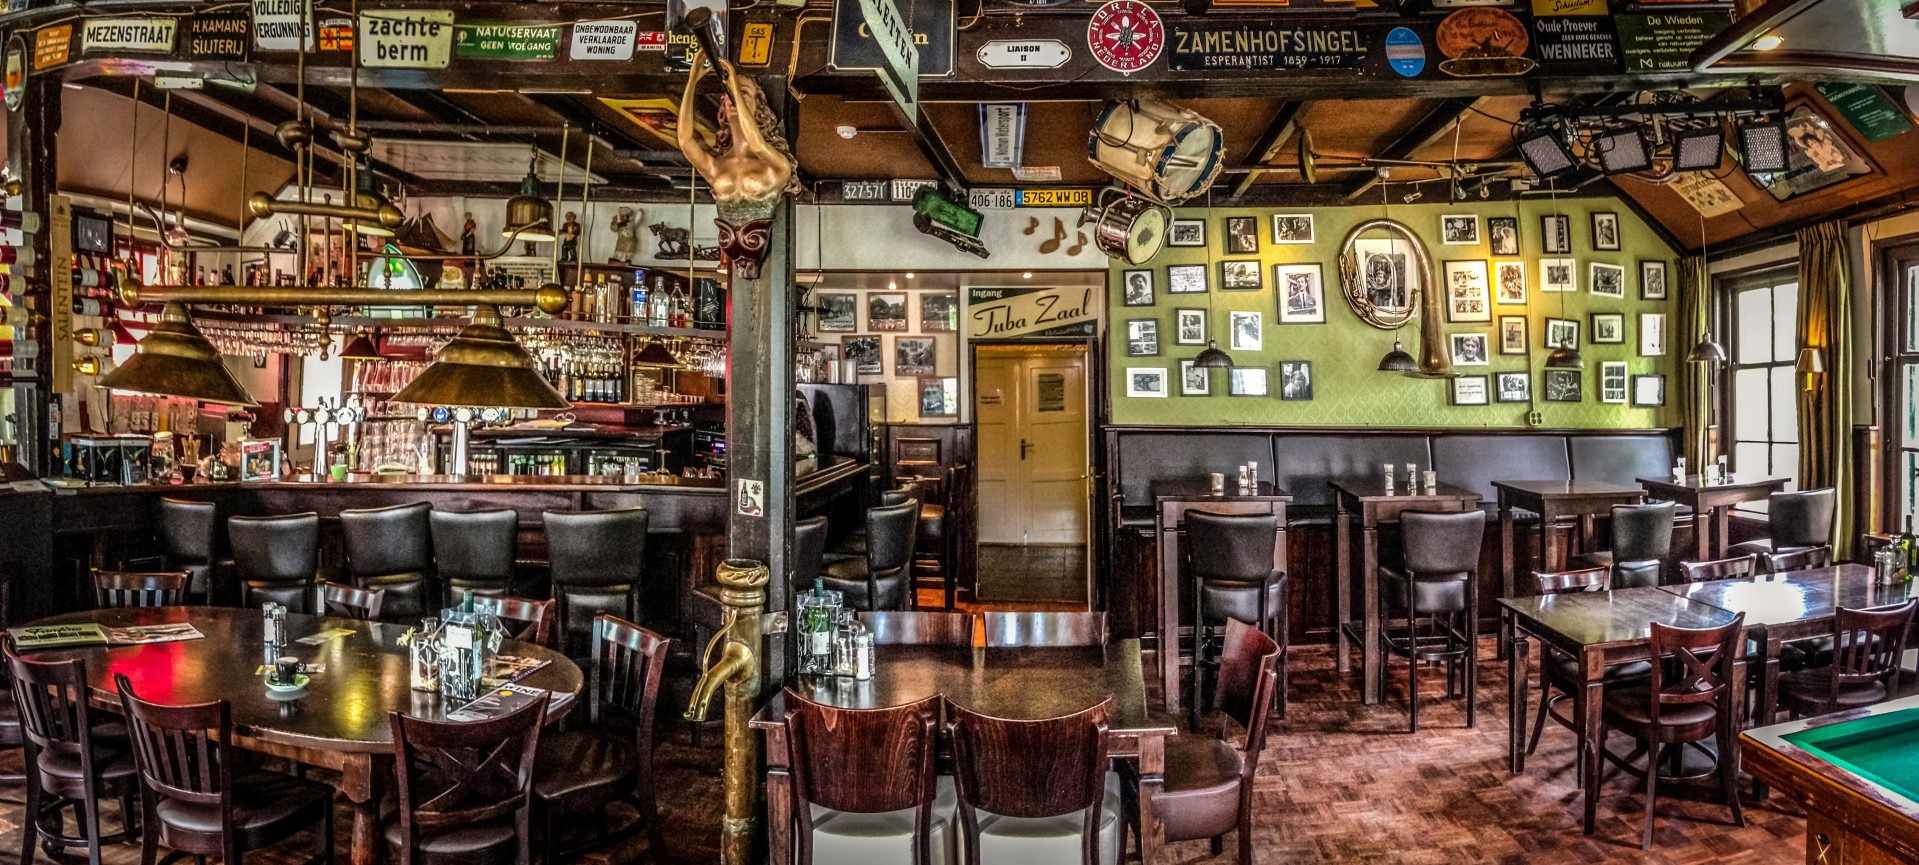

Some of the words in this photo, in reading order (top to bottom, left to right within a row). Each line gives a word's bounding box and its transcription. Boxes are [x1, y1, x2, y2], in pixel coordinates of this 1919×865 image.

[254, 0, 308, 15] VOLLEDIG
[1091, 1, 1159, 31] HORELA
[1647, 16, 1661, 25] De
[1664, 15, 1703, 25] Wieden
[369, 17, 440, 37] zachte
[575, 24, 634, 34] ONBEWOONBAAR
[1536, 18, 1562, 33] Oude
[1562, 18, 1598, 33] Proever
[86, 25, 172, 44] MEZENSTRAAT
[579, 35, 627, 45] VERKLAARDE
[1175, 30, 1368, 54] ZAMENHOFSINGEL
[192, 39, 244, 55] SLIJTERIJ
[376, 40, 428, 61] berm
[480, 41, 504, 50] GEEN
[586, 45, 616, 54] WONING
[1007, 45, 1041, 53] LIAISON
[1539, 43, 1614, 60] WENNEKER
[1093, 41, 1159, 69] NEDERLAND
[1204, 55, 1275, 67] ESPERANTIST
[1283, 55, 1308, 66] 1859
[1319, 55, 1342, 66] 1917
[1023, 191, 1053, 204] 5762
[1055, 191, 1071, 203] WW
[1073, 191, 1089, 203] 08
[56, 255, 70, 342] SALENTEIN
[972, 288, 1003, 299] Ingang
[973, 304, 1028, 338] Tuba
[1034, 288, 1092, 326] Zaal
[504, 684, 541, 697] WINE
